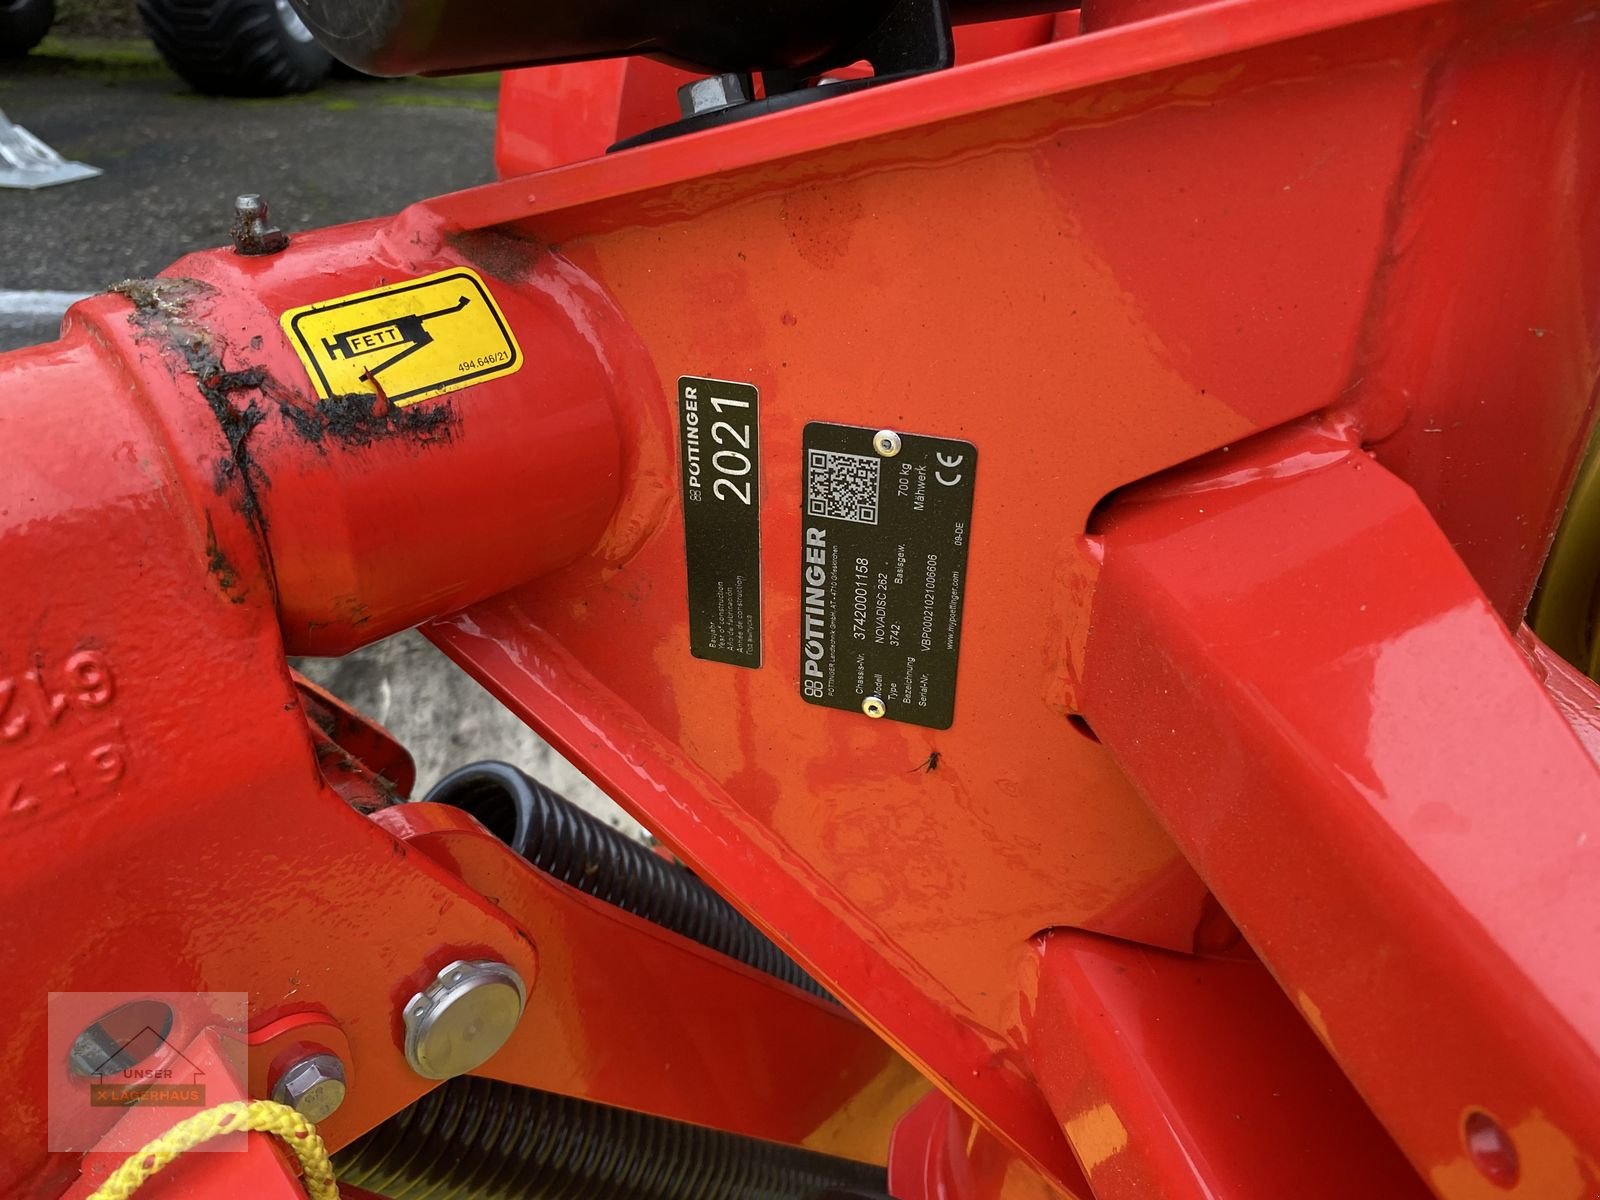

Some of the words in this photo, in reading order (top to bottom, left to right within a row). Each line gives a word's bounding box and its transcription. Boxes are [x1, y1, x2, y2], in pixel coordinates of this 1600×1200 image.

[351, 328, 398, 350] FETT
[458, 350, 509, 372] 494.646/21
[711, 397, 751, 505] 2021
[900, 463, 911, 475] kg
[898, 479, 908, 496] 700
[878, 573, 888, 590] 262
[894, 543, 906, 584] Basisgew.
[853, 558, 869, 640] 37420001158
[903, 656, 915, 704] Bezeichnung
[913, 465, 926, 511] Mähwerk
[921, 554, 937, 651] VBP00021021006606
[946, 571, 959, 649] www.mypoettinger.com
[954, 522, 963, 545] 09-DE
[875, 593, 886, 644] NOVADISC
[890, 625, 900, 646] 3742
[856, 652, 865, 694] Chassis-Nr.
[888, 683, 897, 700] Type
[919, 673, 929, 707] Serial-Nr.
